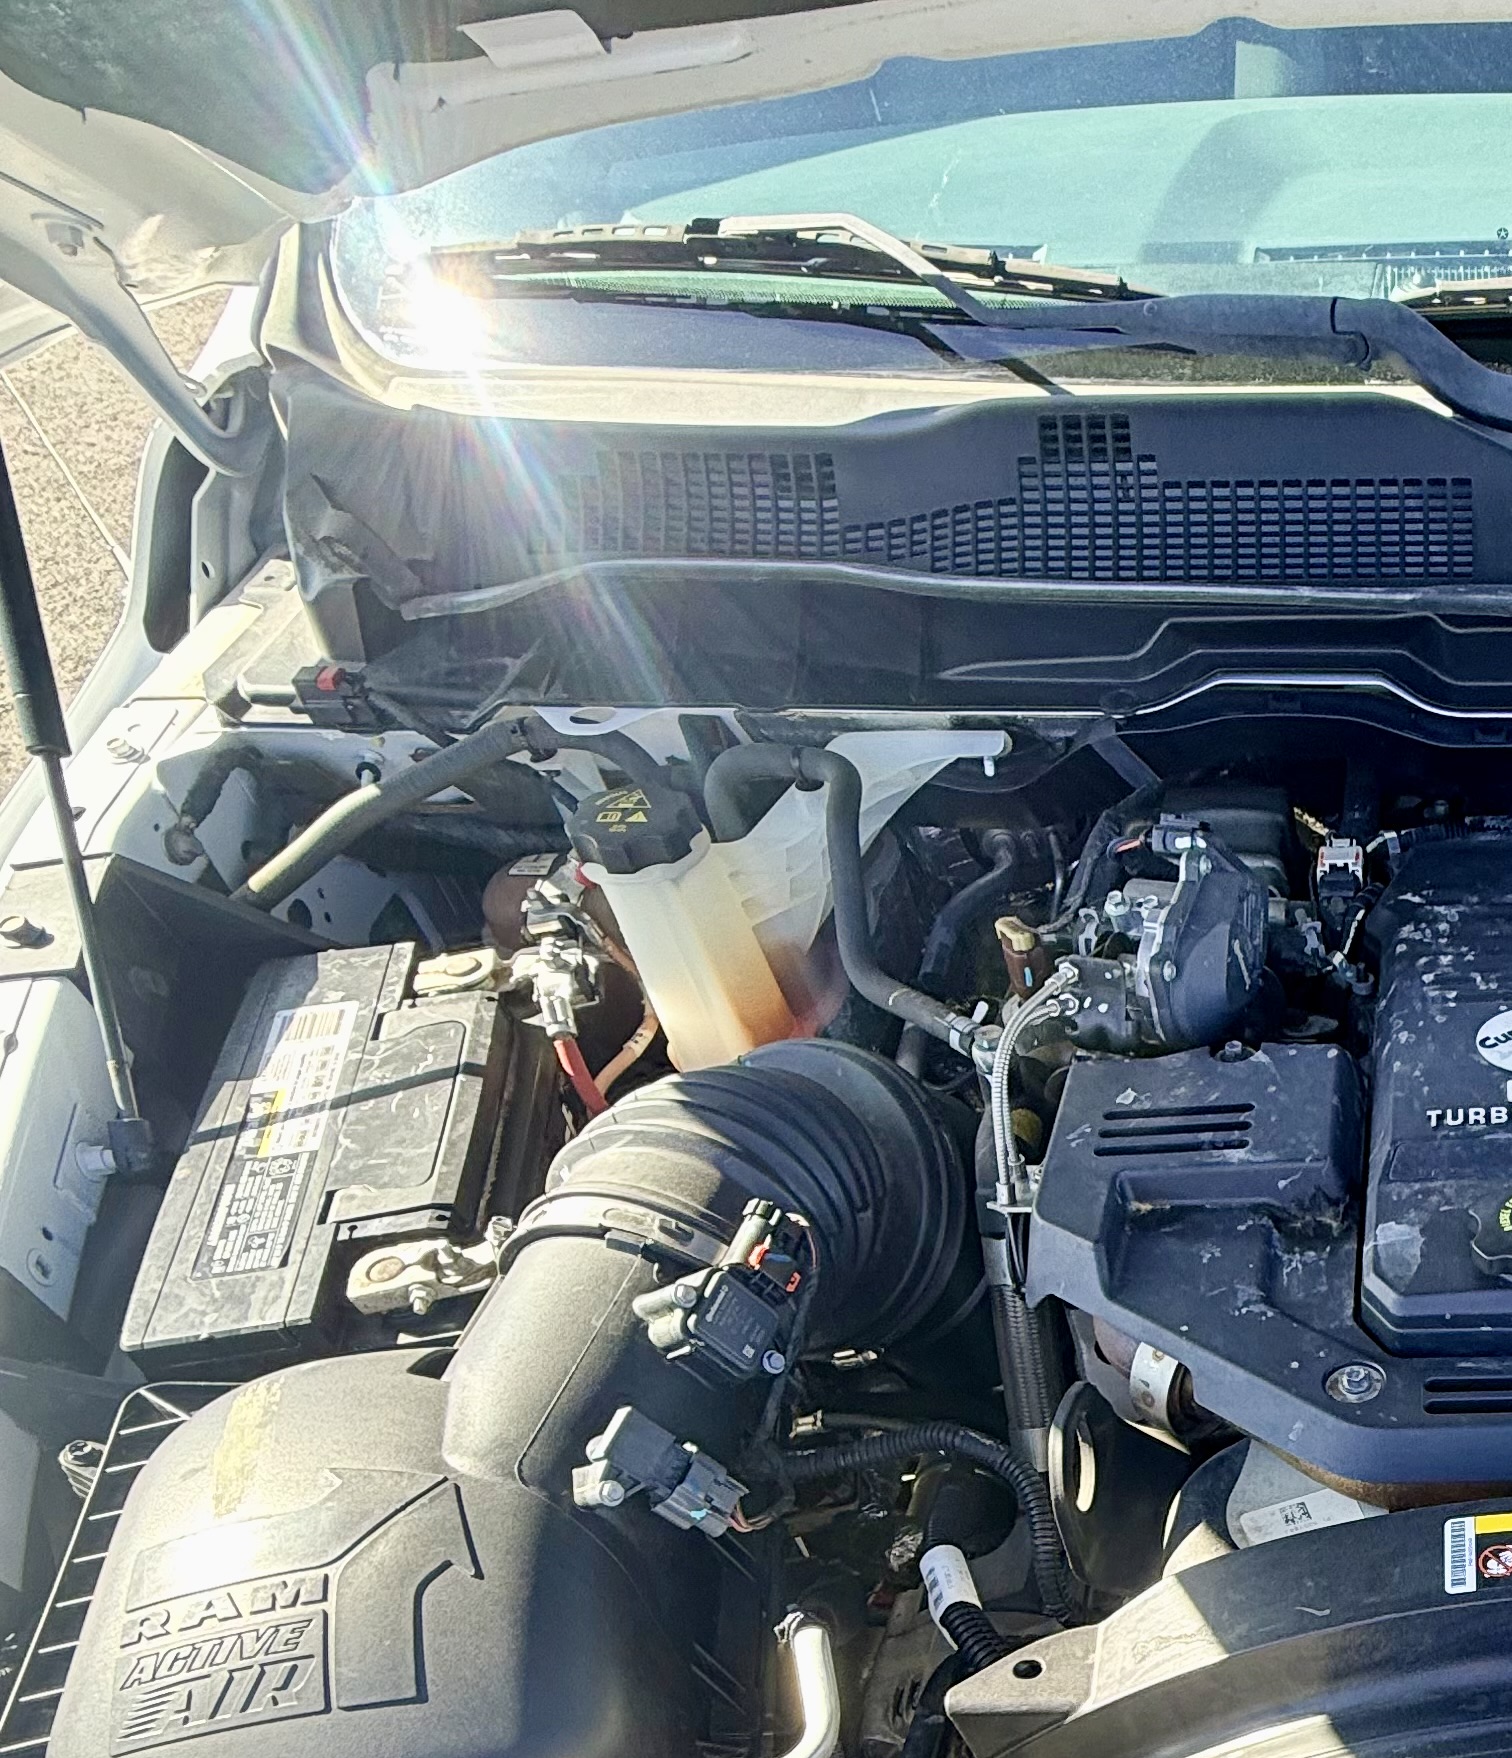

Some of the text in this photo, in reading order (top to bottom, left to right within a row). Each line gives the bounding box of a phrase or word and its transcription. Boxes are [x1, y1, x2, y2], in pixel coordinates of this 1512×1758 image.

[120, 1572, 329, 1650] RAM
[119, 1618, 314, 1692] ACTIVE
[148, 1657, 316, 1734] AIR
